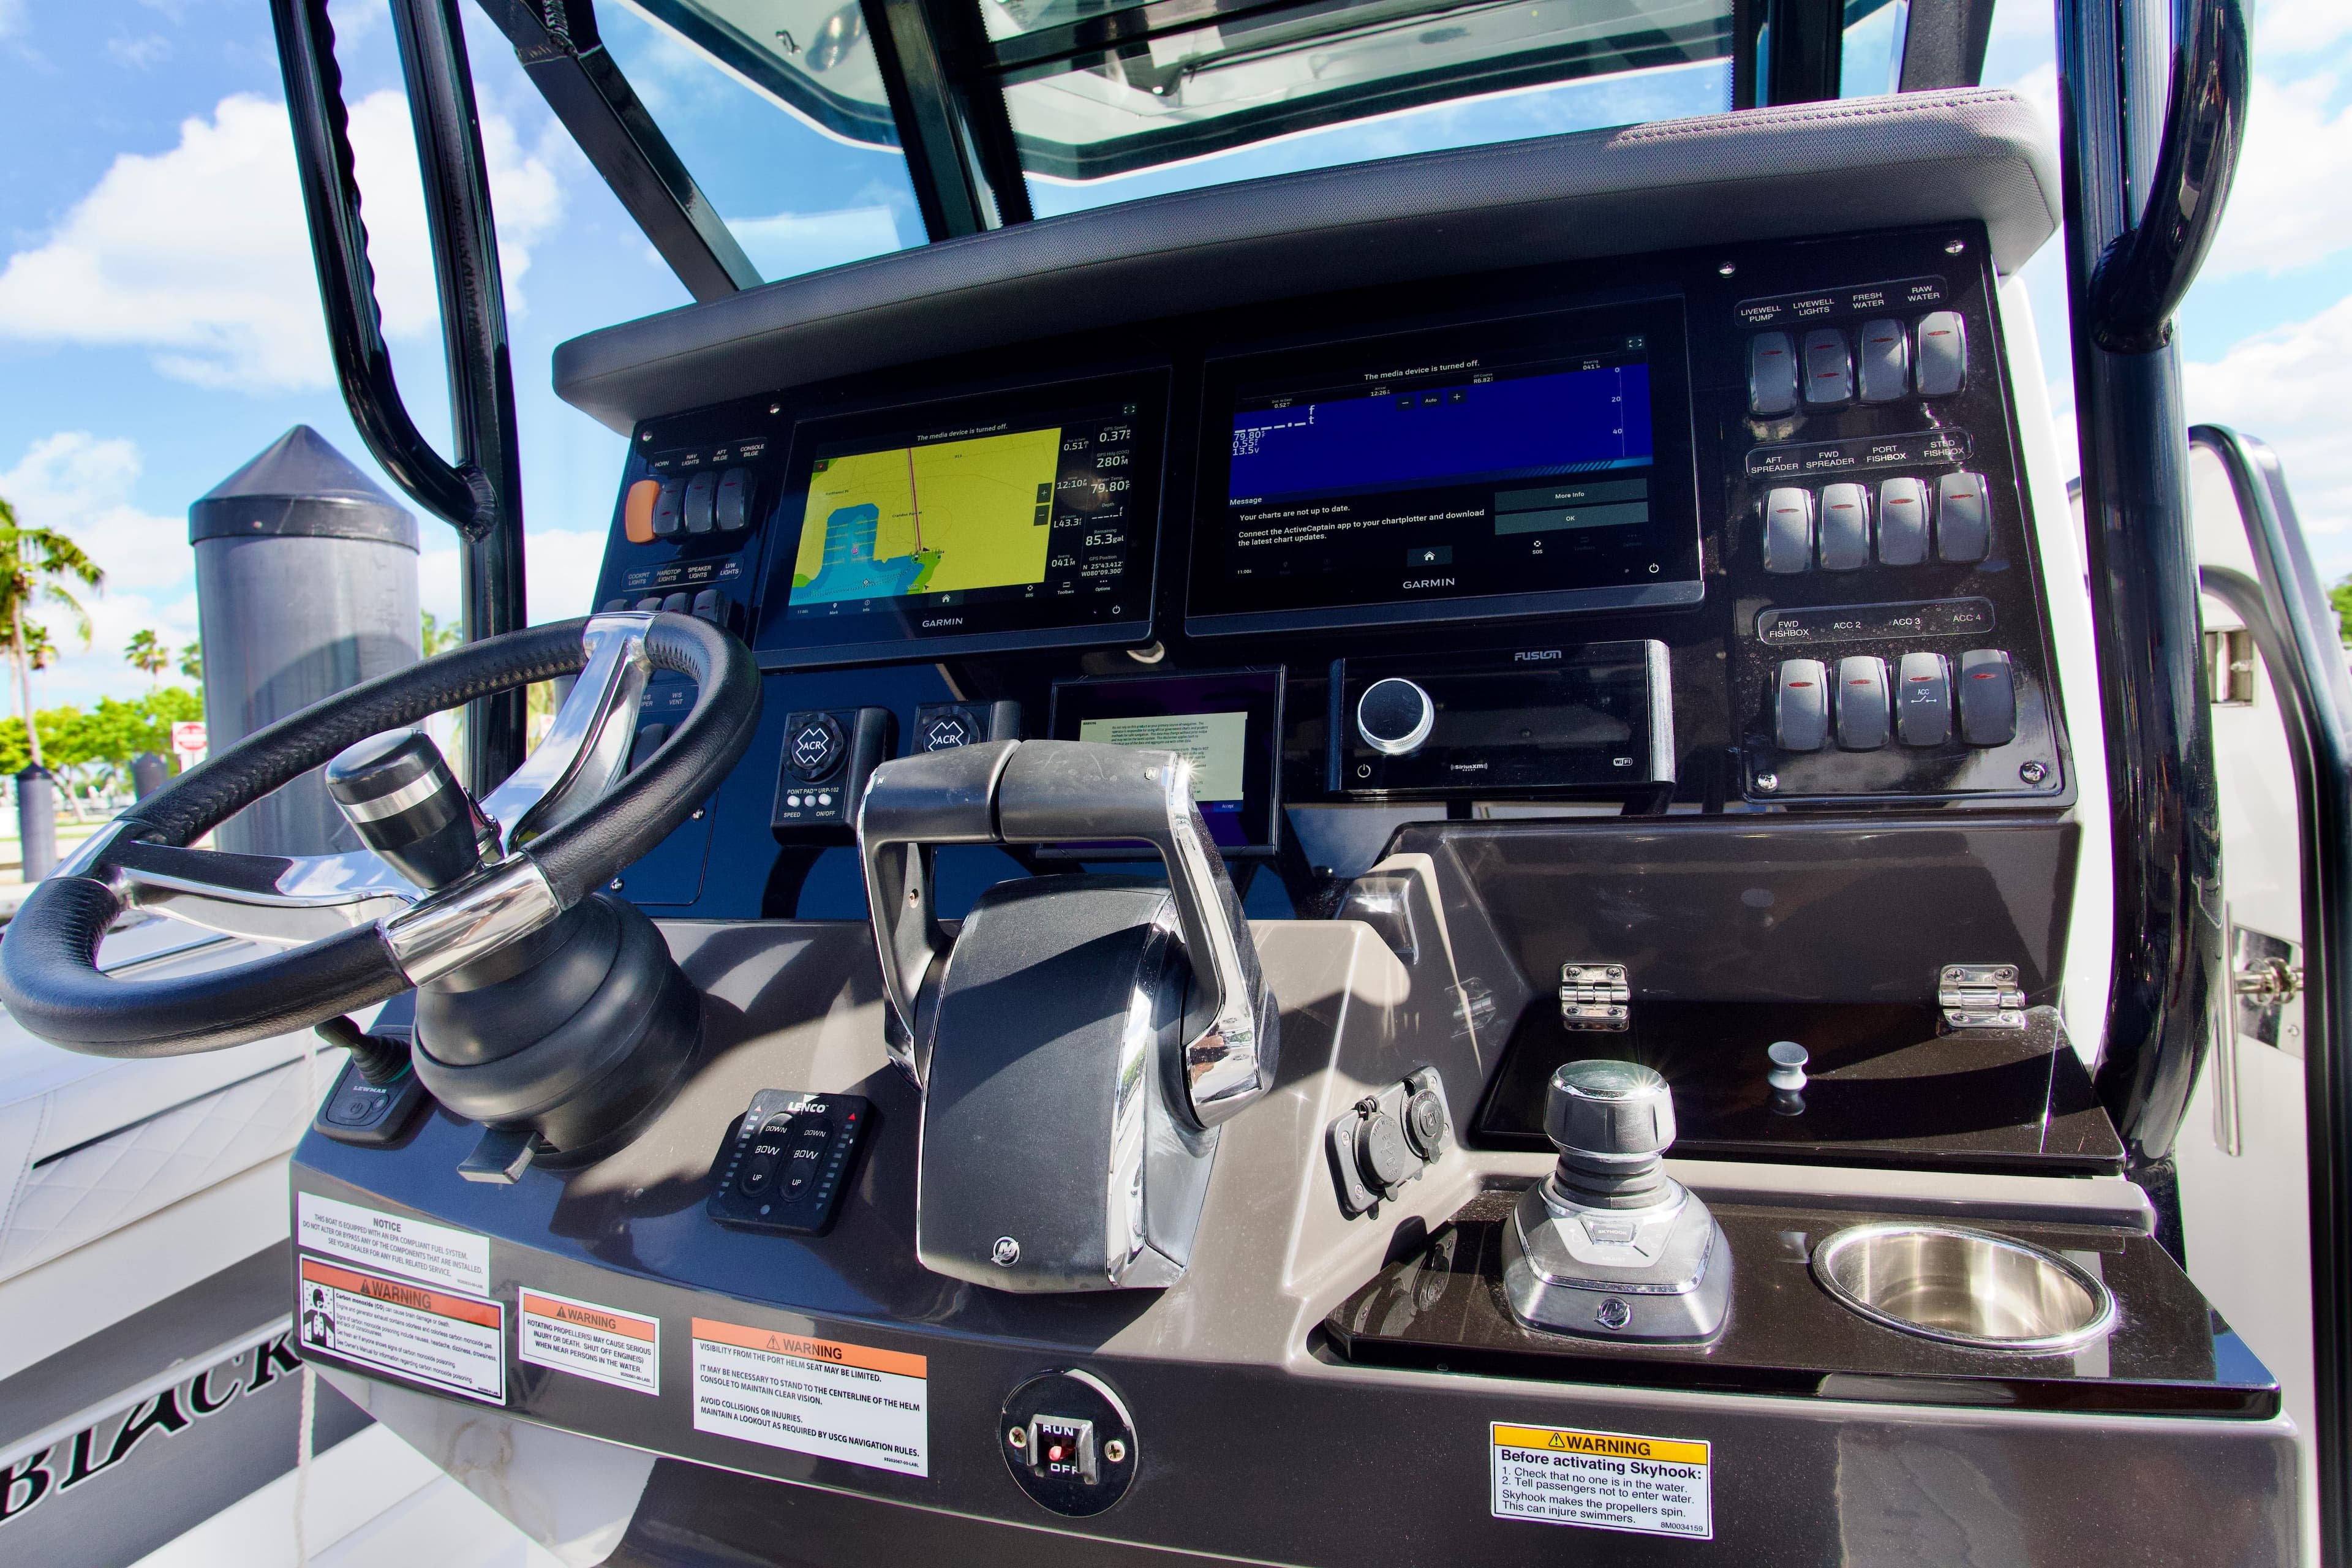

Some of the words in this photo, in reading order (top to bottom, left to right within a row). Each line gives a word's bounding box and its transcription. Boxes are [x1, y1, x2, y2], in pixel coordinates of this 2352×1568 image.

[1912, 285, 1932, 294] RAW
[1853, 292, 1882, 301] FRESH
[1907, 292, 1940, 302] WATER
[1793, 298, 1834, 309] LIVEWELL
[1853, 299, 1884, 309] WATER
[1741, 306, 1781, 316] LIVEWELL
[1749, 314, 1773, 322] PUMP
[1405, 367, 1429, 375] device
[1439, 361, 1464, 371] turned
[1872, 445, 1897, 454] PORT
[1924, 447, 1964, 457] FISHBOX
[1866, 452, 1906, 462] FISHBOX
[1751, 462, 1798, 473] SPREADER
[1806, 458, 1855, 469] SPREADER
[1230, 497, 1262, 506] Message
[1239, 529, 1268, 538] Connect
[1284, 522, 1335, 533] ActiveCaptain
[1363, 519, 1379, 528] your
[1382, 514, 1427, 526] chartplotter
[1446, 510, 1484, 519] download
[1403, 578, 1455, 589] GARMIN
[922, 617, 963, 627] GARMIN
[1770, 629, 1809, 638] FISHBOX
[1515, 650, 1562, 661] FUSION
[936, 735, 956, 744] ACR
[803, 742, 821, 750] ACR
[755, 1145, 780, 1155] BOW
[794, 1150, 818, 1159] BOW
[374, 1218, 401, 1232] NOTICE
[372, 1281, 431, 1310] WARNING
[568, 1308, 616, 1329] WARNING
[783, 1338, 842, 1359] WARNING
[700, 1343, 731, 1355] VISIBILITY
[733, 1349, 752, 1358] FROM
[753, 1352, 766, 1362] THE
[767, 1354, 784, 1364] PORT
[786, 1357, 805, 1369] HELM
[806, 1362, 822, 1371] SEAT
[824, 1365, 839, 1374] MAY
[841, 1368, 850, 1376] BE
[851, 1370, 881, 1382] LIMITED.
[1043, 1425, 1073, 1436] RUN
[1566, 1436, 1651, 1456] WARNING
[1501, 1449, 1549, 1464] Before
[1553, 1458, 1625, 1475] activating
[1630, 1463, 1702, 1479] Skyhook:
[1514, 1468, 1547, 1480] Check
[1550, 1472, 1569, 1482] that
[1611, 1477, 1620, 1487] is
[1623, 1479, 1632, 1487] in
[1636, 1480, 1652, 1489] the
[1655, 1482, 1687, 1493] water.
[1502, 1477, 1511, 1485] 2.
[1514, 1477, 1533, 1488] Tell
[1536, 1480, 1596, 1494] passengers
[1618, 1488, 1628, 1497] to
[1632, 1490, 1659, 1500] enter
[1662, 1494, 1694, 1504] water.
[1502, 1490, 1546, 1503] Skyhook
[1549, 1495, 1583, 1506] makes
[1586, 1499, 1602, 1508] the
[1606, 1502, 1657, 1515] propellers
[1661, 1507, 1686, 1517] spin.
[1503, 1501, 1524, 1510] This
[1527, 1504, 1545, 1513] can
[1548, 1506, 1577, 1518] injure
[1580, 1510, 1636, 1523] swimmers.
[1660, 1522, 1703, 1532] 8M0034159
